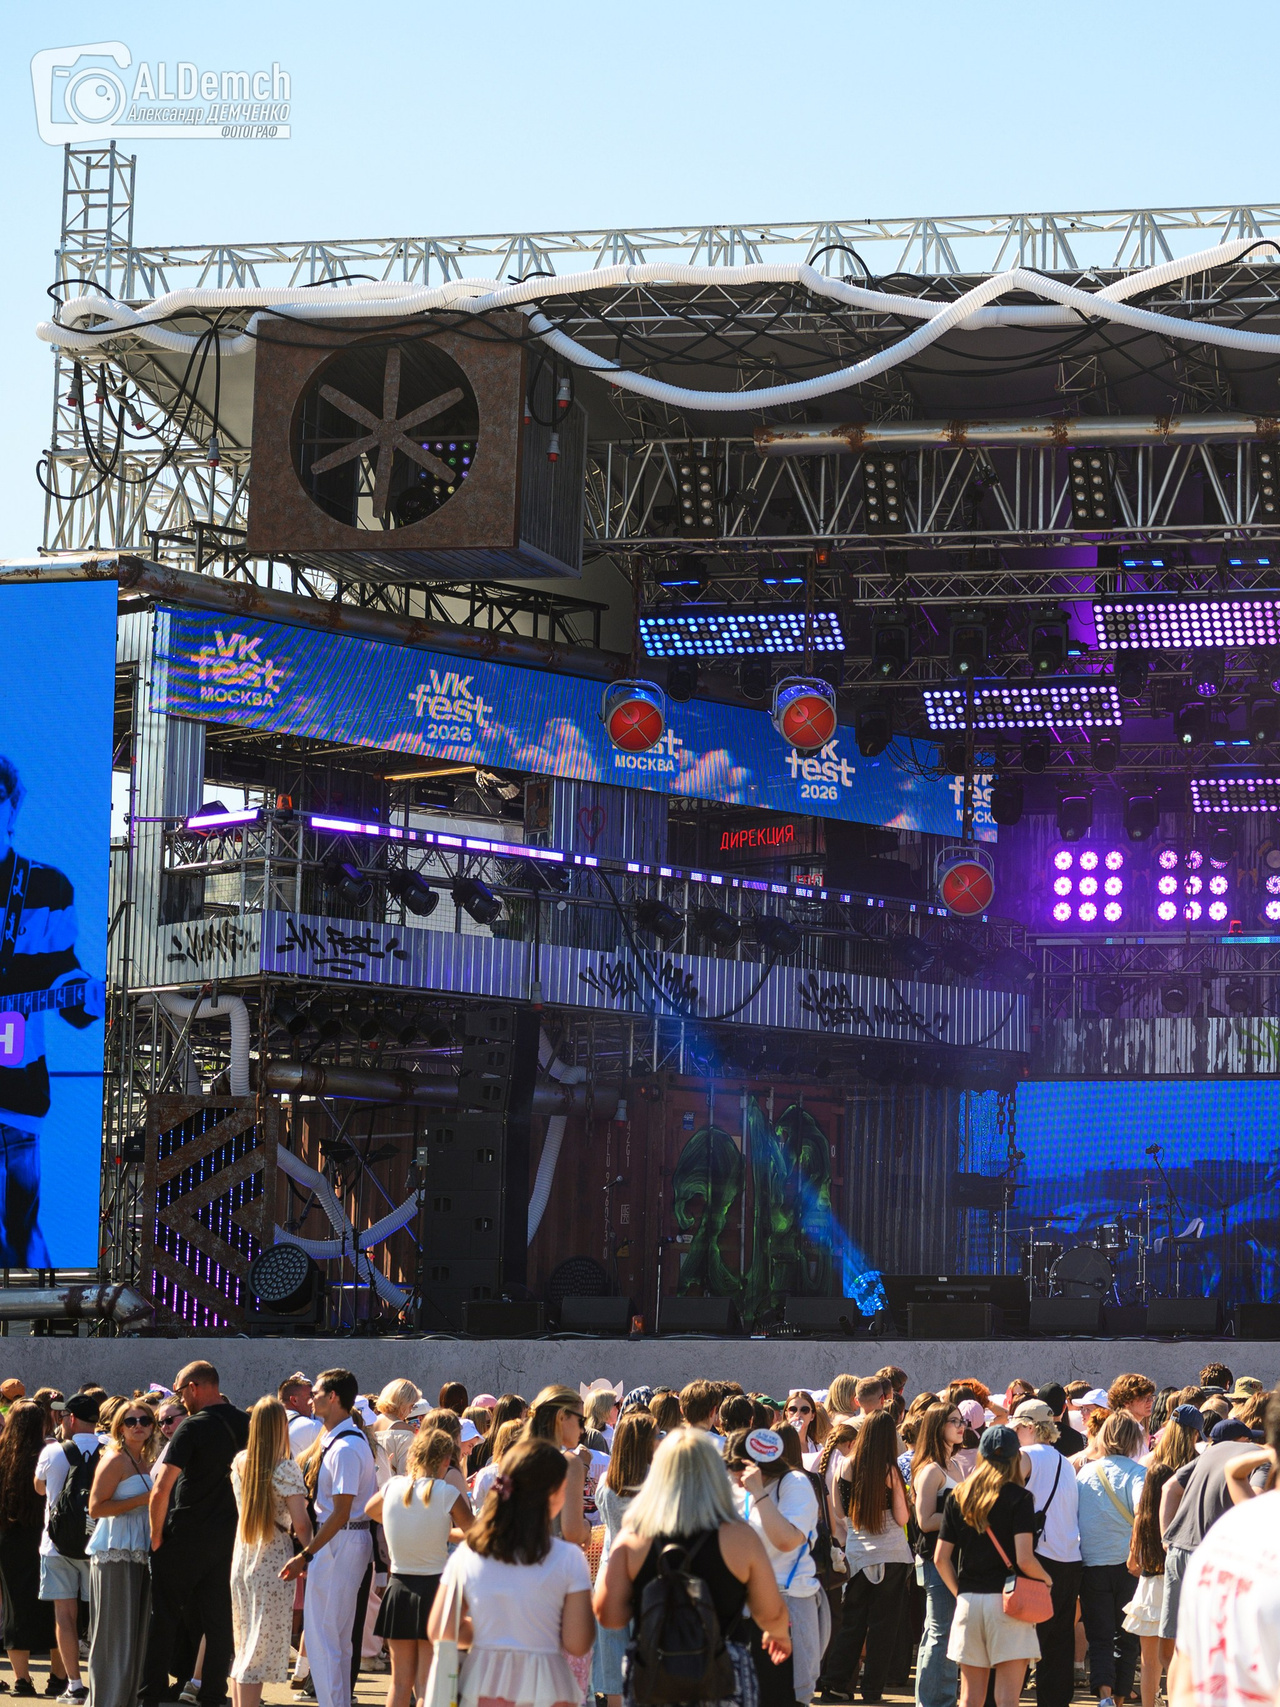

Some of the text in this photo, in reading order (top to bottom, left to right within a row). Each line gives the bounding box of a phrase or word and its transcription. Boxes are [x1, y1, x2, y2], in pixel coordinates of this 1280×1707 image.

[214, 630, 264, 663] VK
[190, 646, 285, 693] fest
[200, 686, 274, 707] МОСКВА
[429, 669, 474, 700] VK
[408, 683, 493, 729] fest
[427, 723, 472, 742] 2026
[615, 754, 676, 772] МОСКВА
[801, 784, 838, 800] 2026
[720, 824, 794, 851] ДИРЕКЦИЯ
